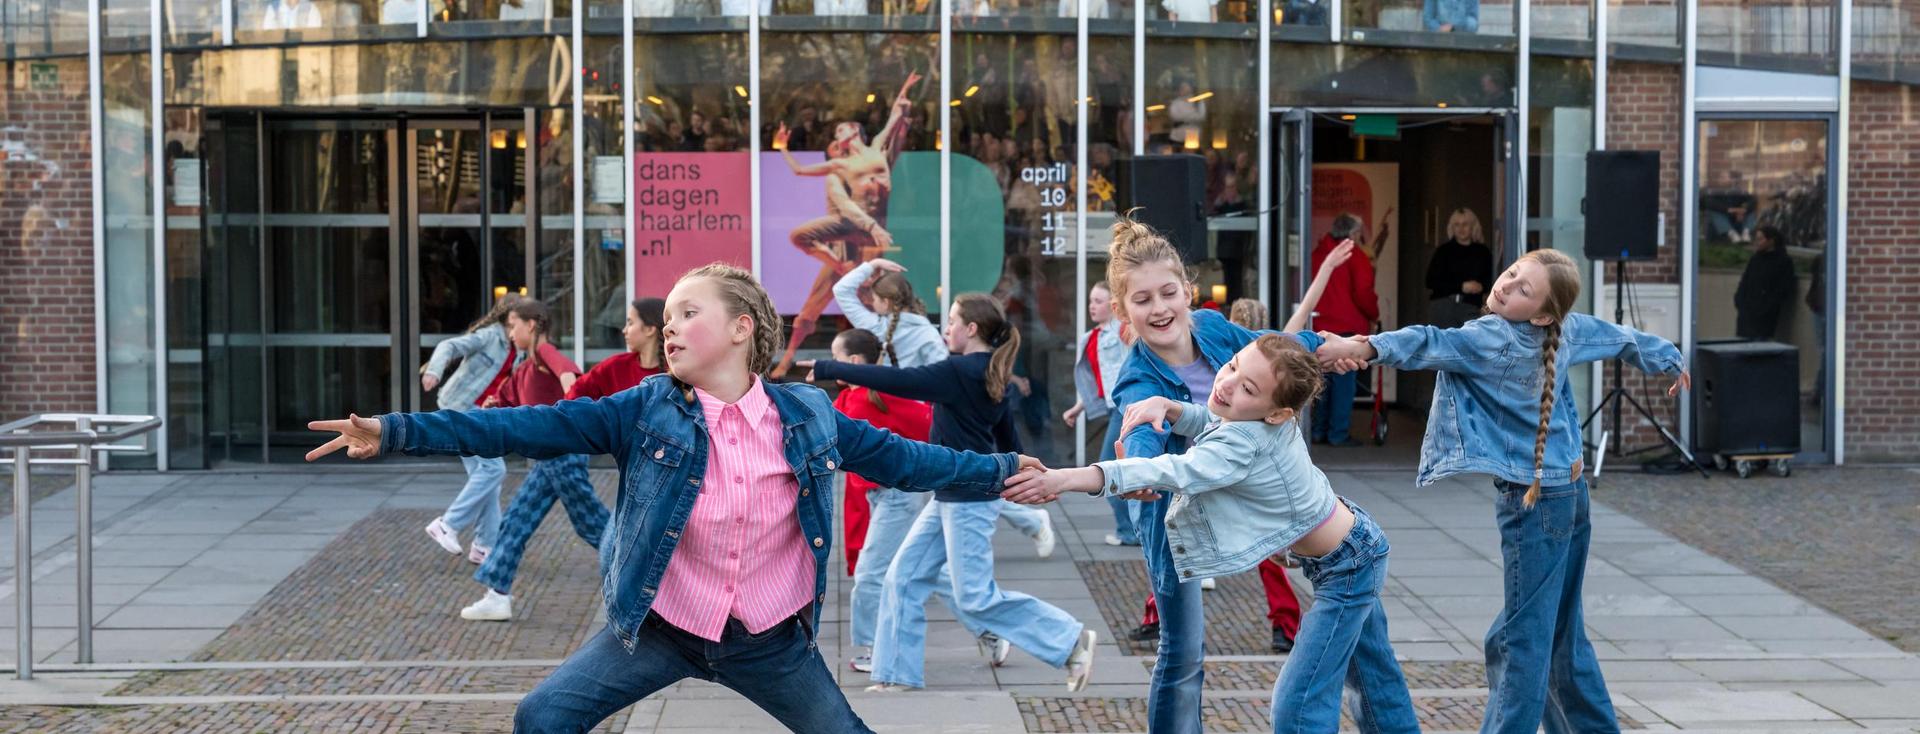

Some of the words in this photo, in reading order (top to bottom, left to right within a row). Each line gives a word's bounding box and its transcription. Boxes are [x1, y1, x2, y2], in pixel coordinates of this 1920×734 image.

[640, 159, 701, 180] dans
[1021, 162, 1066, 186] april
[640, 184, 719, 211] dagen
[1040, 187, 1066, 207] 10
[640, 209, 742, 231] haarlem
[1041, 212, 1067, 231] 11
[641, 235, 671, 256] .nl
[1040, 236, 1066, 255] 12
